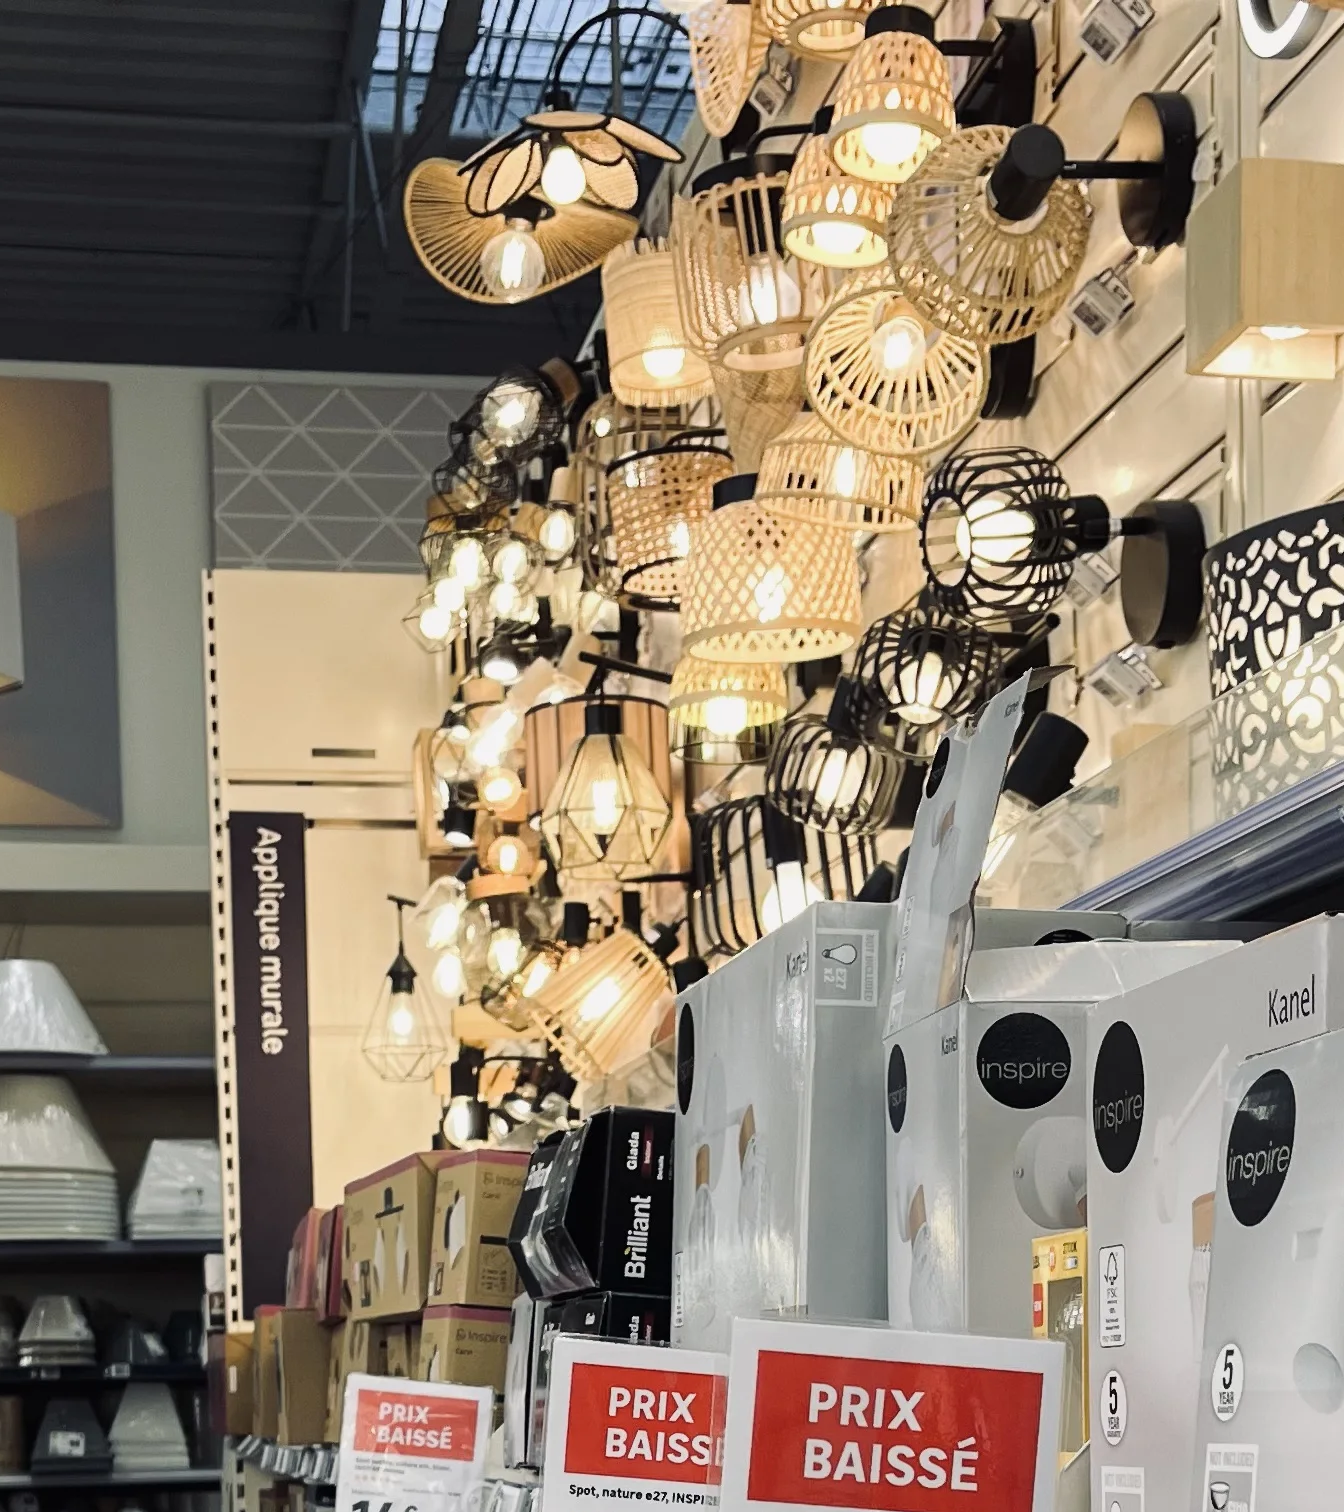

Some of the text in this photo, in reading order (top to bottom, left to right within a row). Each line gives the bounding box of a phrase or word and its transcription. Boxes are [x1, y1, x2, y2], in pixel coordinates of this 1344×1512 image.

[251, 826, 285, 1057] Applique murale
[1268, 973, 1316, 1028] Kanel
[980, 1057, 1068, 1084] inspire
[1094, 1090, 1144, 1133] inspire
[626, 1130, 640, 1171] Glada
[1227, 1140, 1291, 1187] inspire
[623, 1194, 652, 1279] Brilliant
[468, 1328, 507, 1344] Inspire
[628, 1315, 641, 1344] ada
[1222, 1349, 1235, 1390] 5
[378, 1402, 430, 1425] PRIX
[607, 1386, 698, 1424] PRIX
[808, 1382, 926, 1433] PRIX
[1108, 1376, 1118, 1415] 5
[1219, 1391, 1235, 1405] YEAR
[375, 1426, 453, 1451] BAISSÉ
[802, 1436, 980, 1493] BAISSÉ
[569, 1484, 670, 1504] Spot, nature e27,
